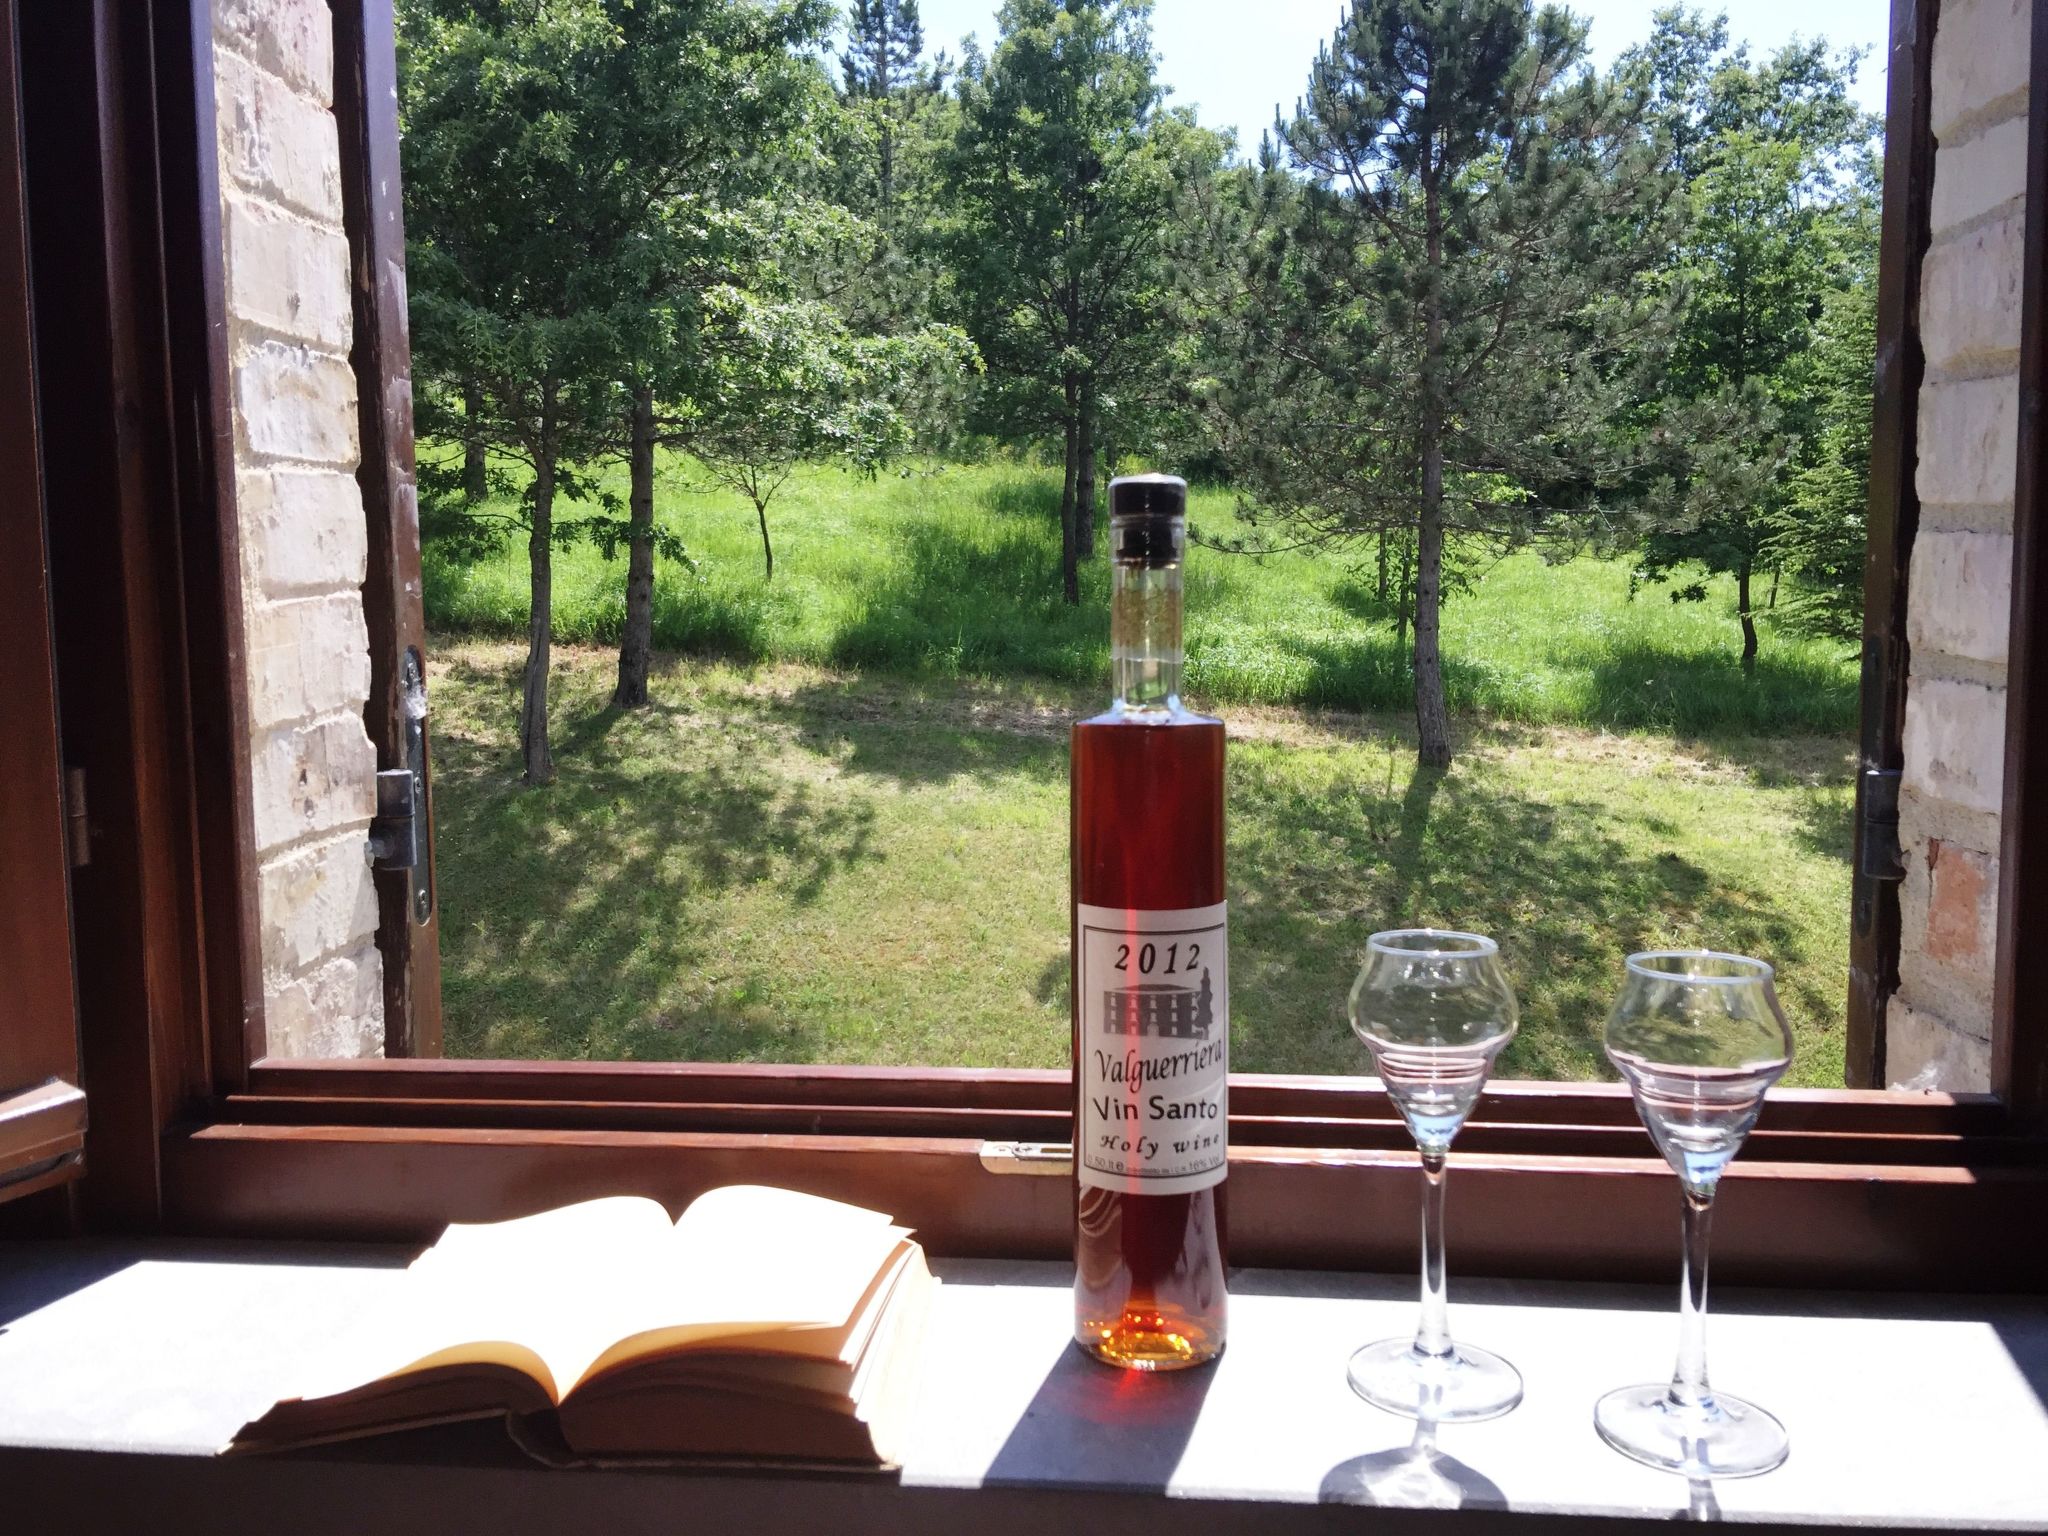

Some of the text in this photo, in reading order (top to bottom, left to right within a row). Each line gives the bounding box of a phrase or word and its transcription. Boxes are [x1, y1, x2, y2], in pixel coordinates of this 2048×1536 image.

[1115, 943, 1200, 974] 2012
[1095, 1039, 1222, 1093] Valguerriera
[1093, 1095, 1218, 1121] Vin Santo
[1100, 1133, 1219, 1160] Holy wine
